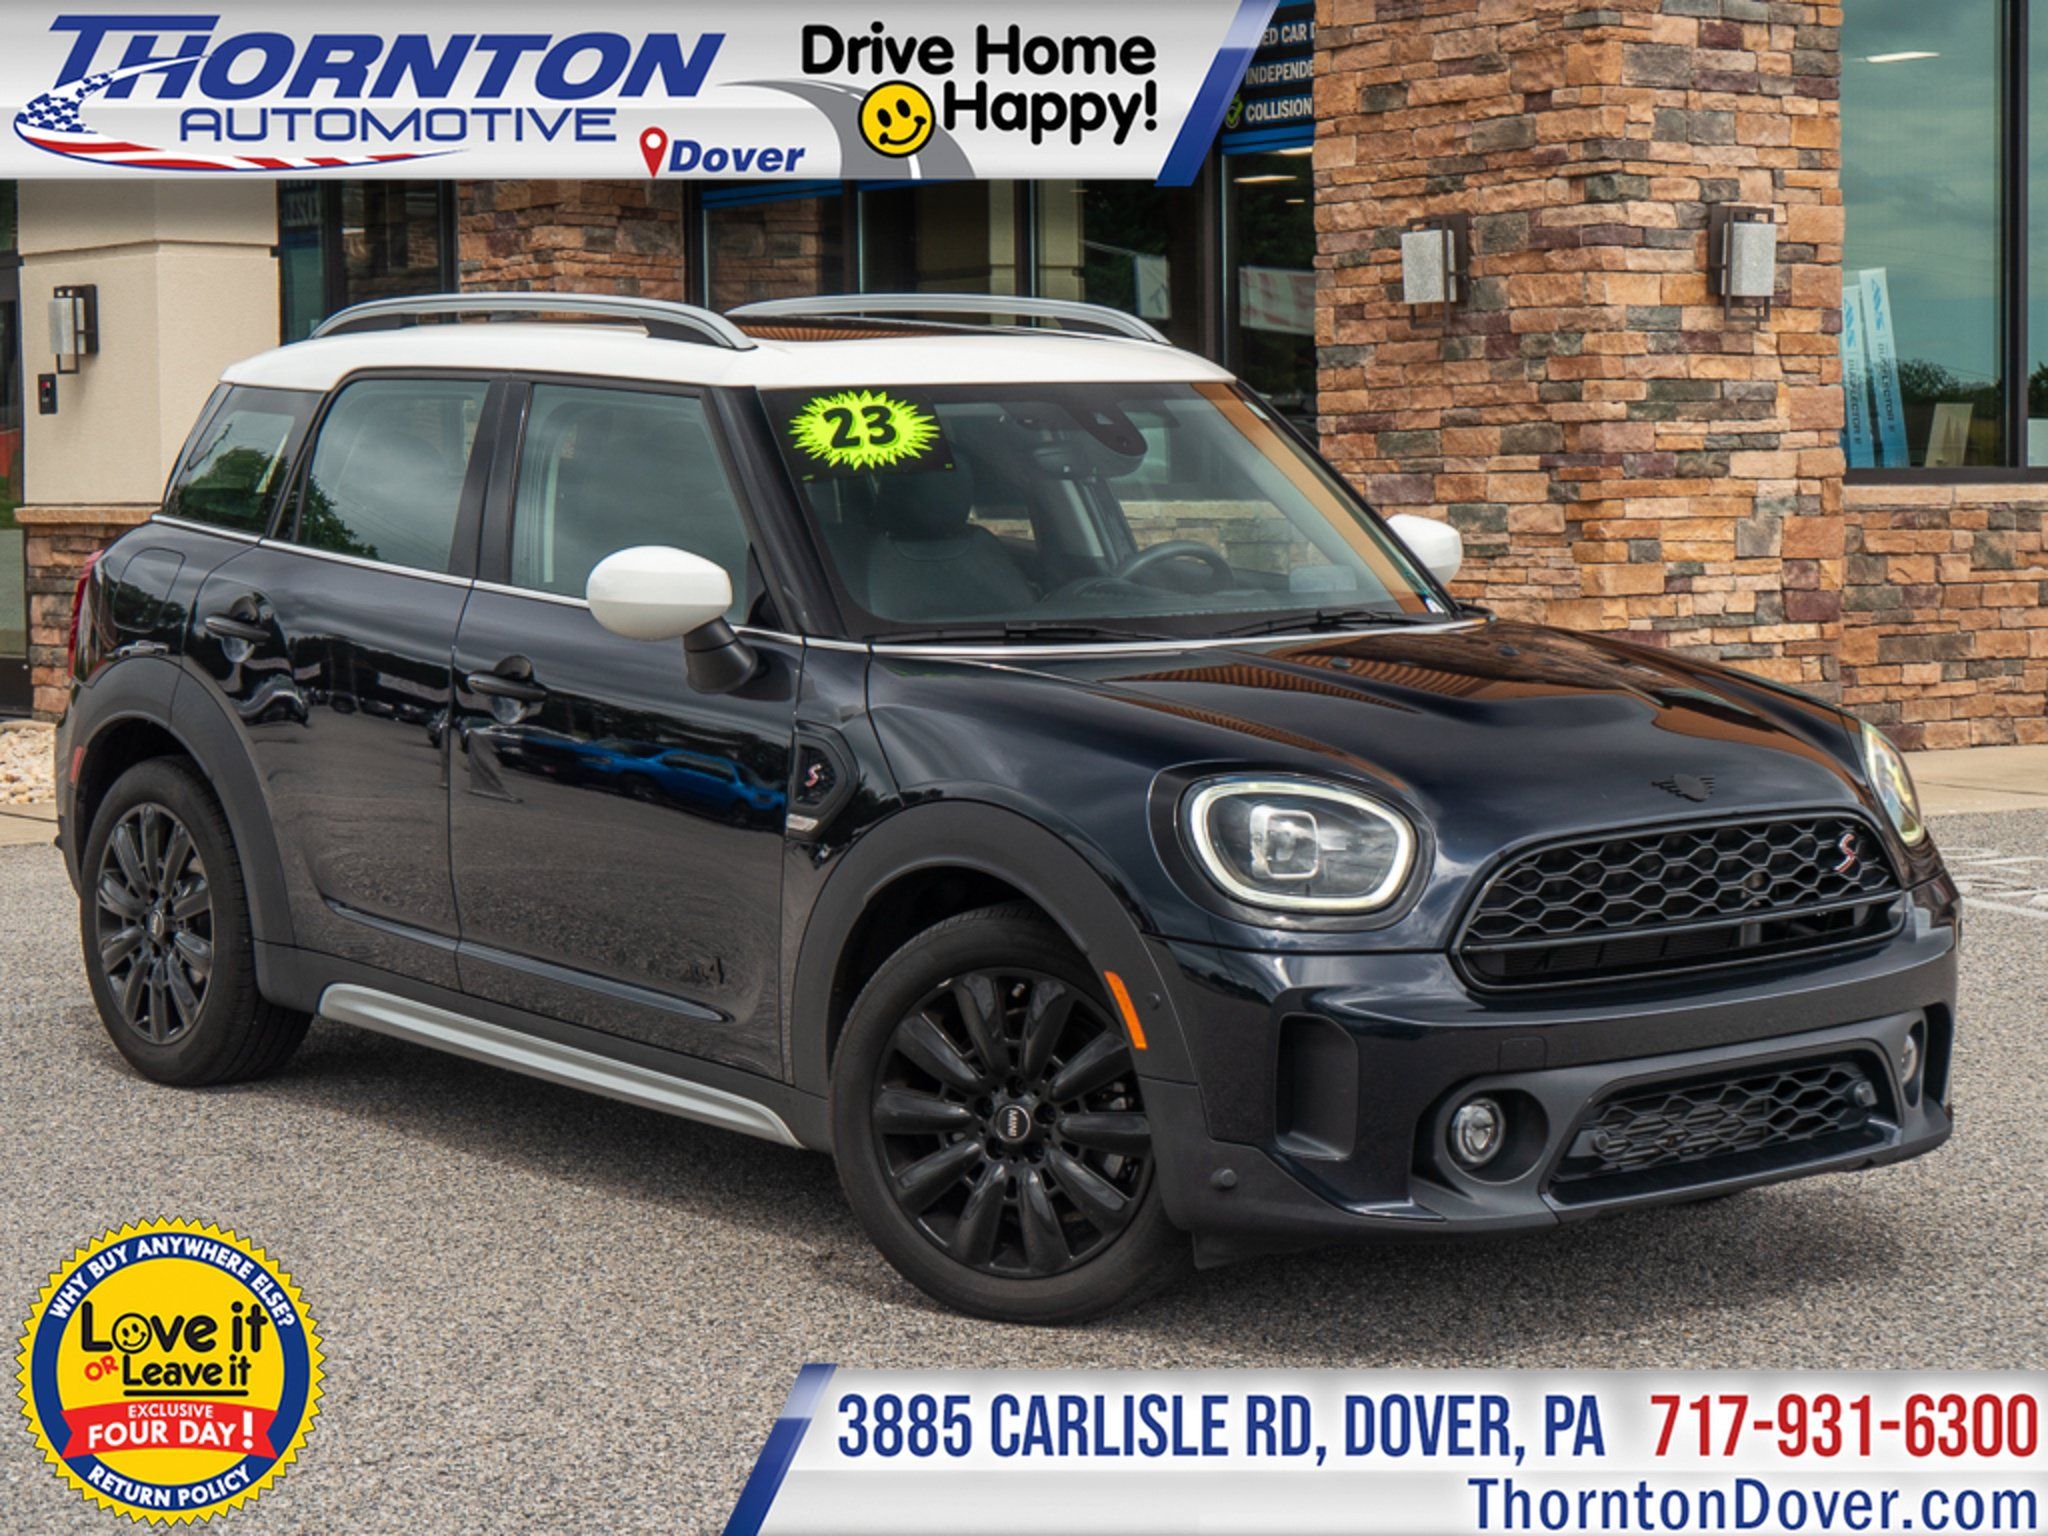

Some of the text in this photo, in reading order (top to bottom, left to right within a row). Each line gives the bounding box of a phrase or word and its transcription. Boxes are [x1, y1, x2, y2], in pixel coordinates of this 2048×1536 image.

[1281, 23, 1307, 43] CAR
[1245, 97, 1313, 122] COLLISION
[822, 405, 897, 449] 23
[1834, 833, 1855, 873] S
